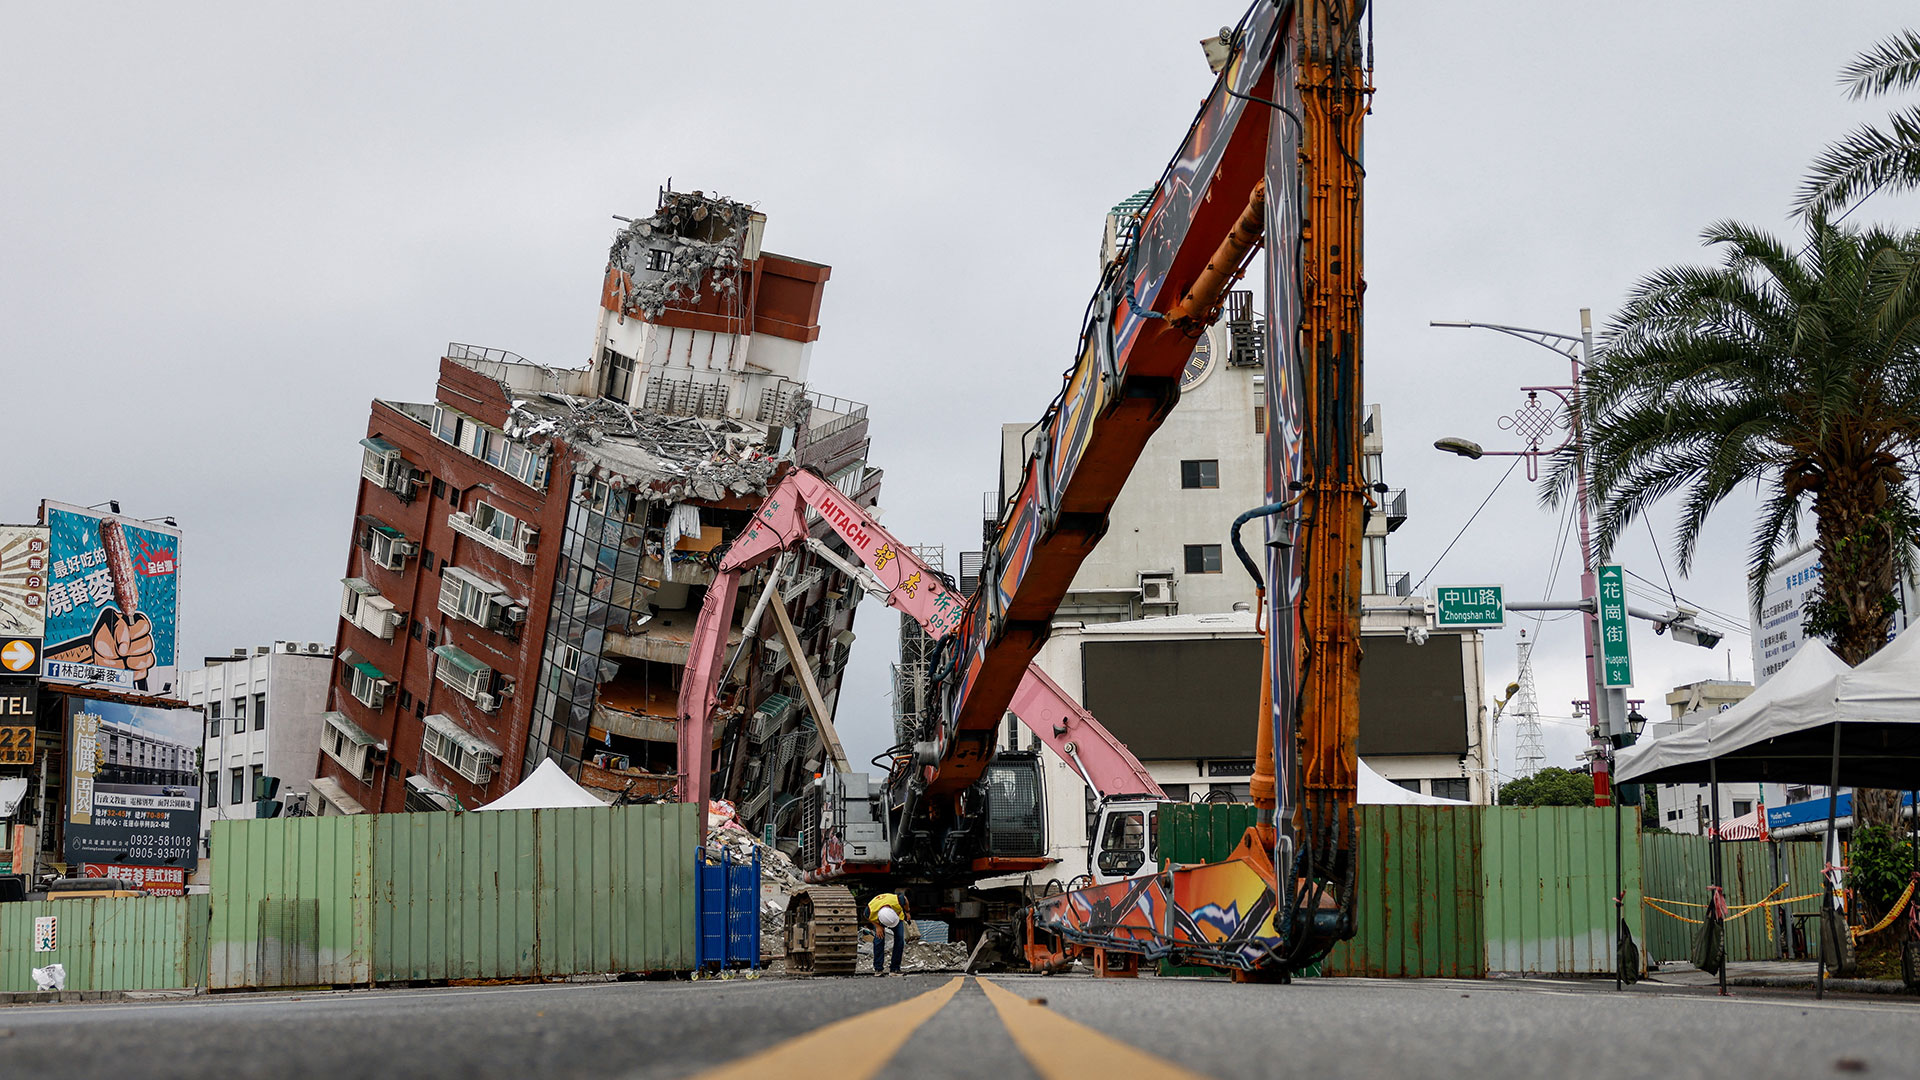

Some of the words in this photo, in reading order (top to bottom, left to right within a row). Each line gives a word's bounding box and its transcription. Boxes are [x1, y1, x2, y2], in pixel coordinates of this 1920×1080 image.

[820, 497, 871, 550] HITACHI
[53, 547, 108, 578] 最好吃的
[148, 560, 174, 574] 全台灣
[1444, 589, 1495, 606] 中山路
[933, 591, 963, 625] 拆除
[1603, 582, 1623, 642] 花崗街
[1444, 611, 1484, 623] Zhongshan
[1485, 610, 1497, 619] Rd.
[1605, 654, 1627, 667] Huagang
[0, 728, 32, 748] 22
[130, 834, 191, 847] 0932-581018
[129, 847, 190, 859] 0905-935071
[145, 868, 182, 883] 美式炸雞
